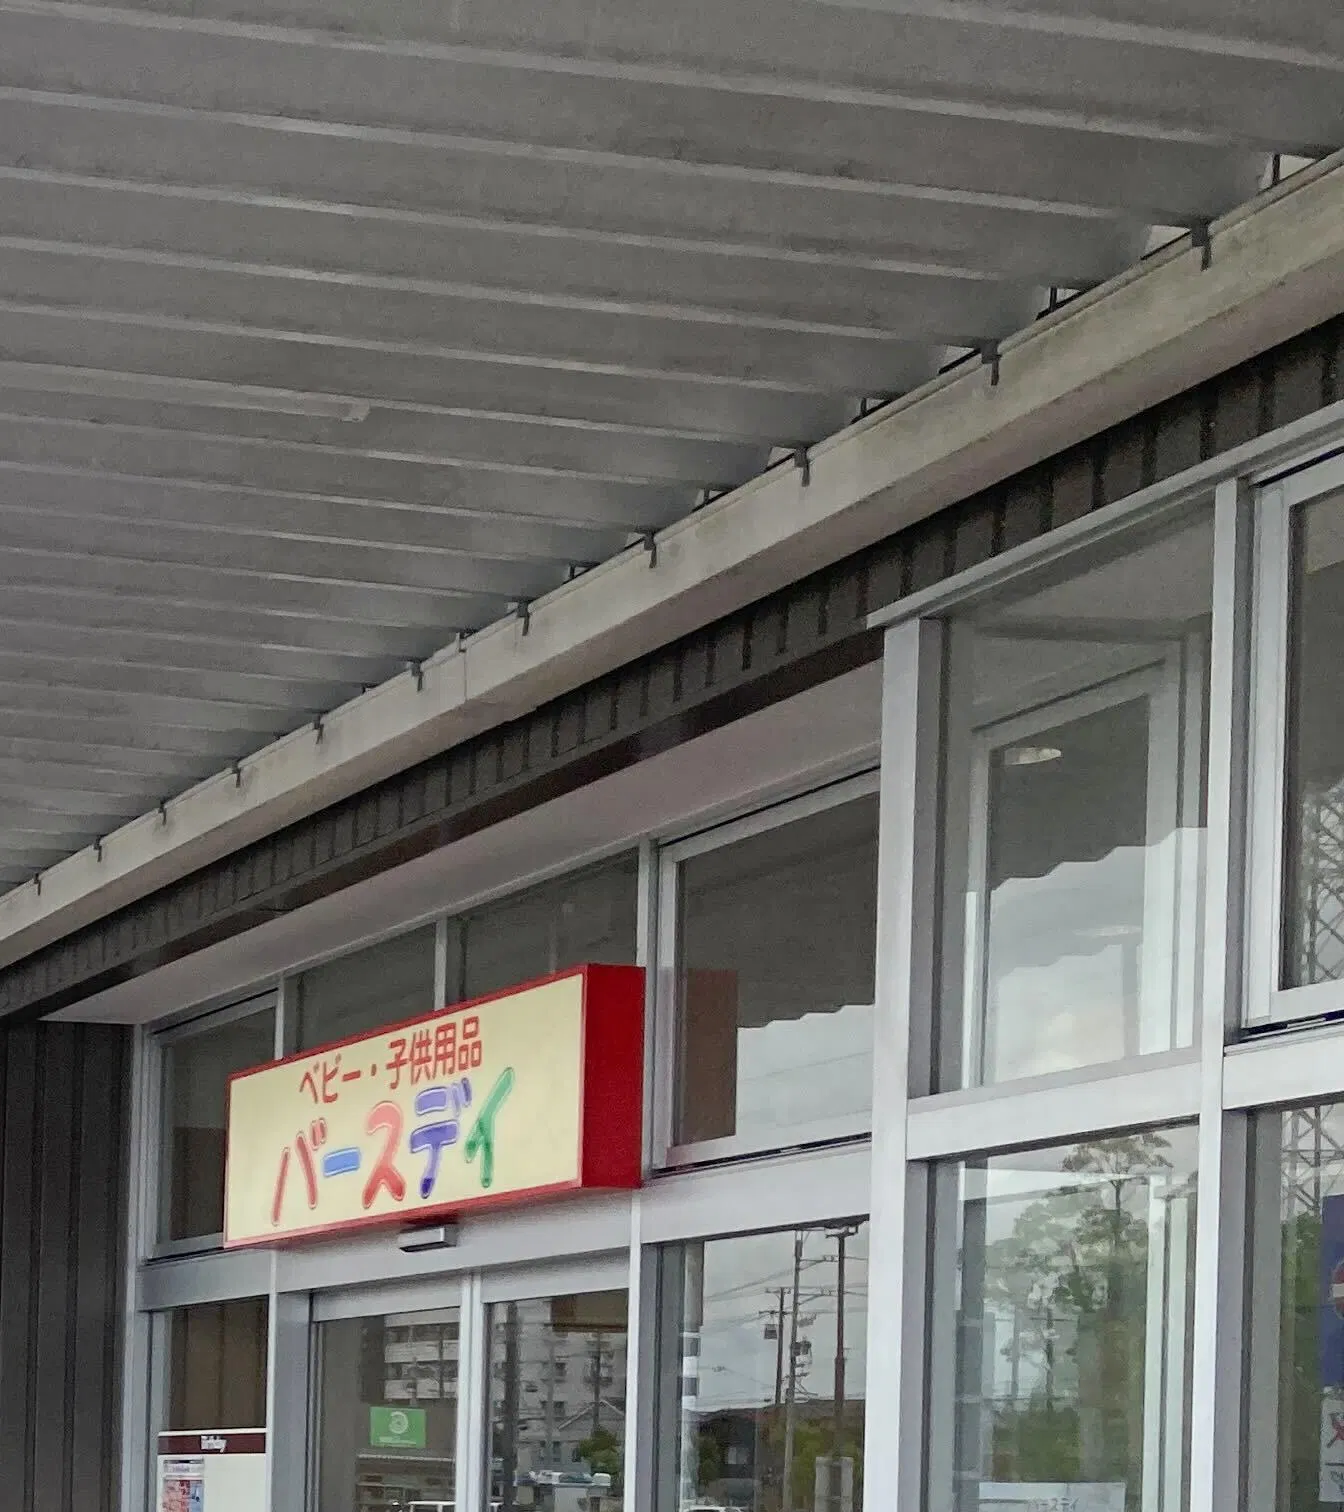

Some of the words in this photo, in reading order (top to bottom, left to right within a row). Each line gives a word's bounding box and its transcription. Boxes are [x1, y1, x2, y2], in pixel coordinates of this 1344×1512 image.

[298, 1015, 483, 1104] ベビー・子供用品
[270, 1066, 516, 1226] バースデイ
